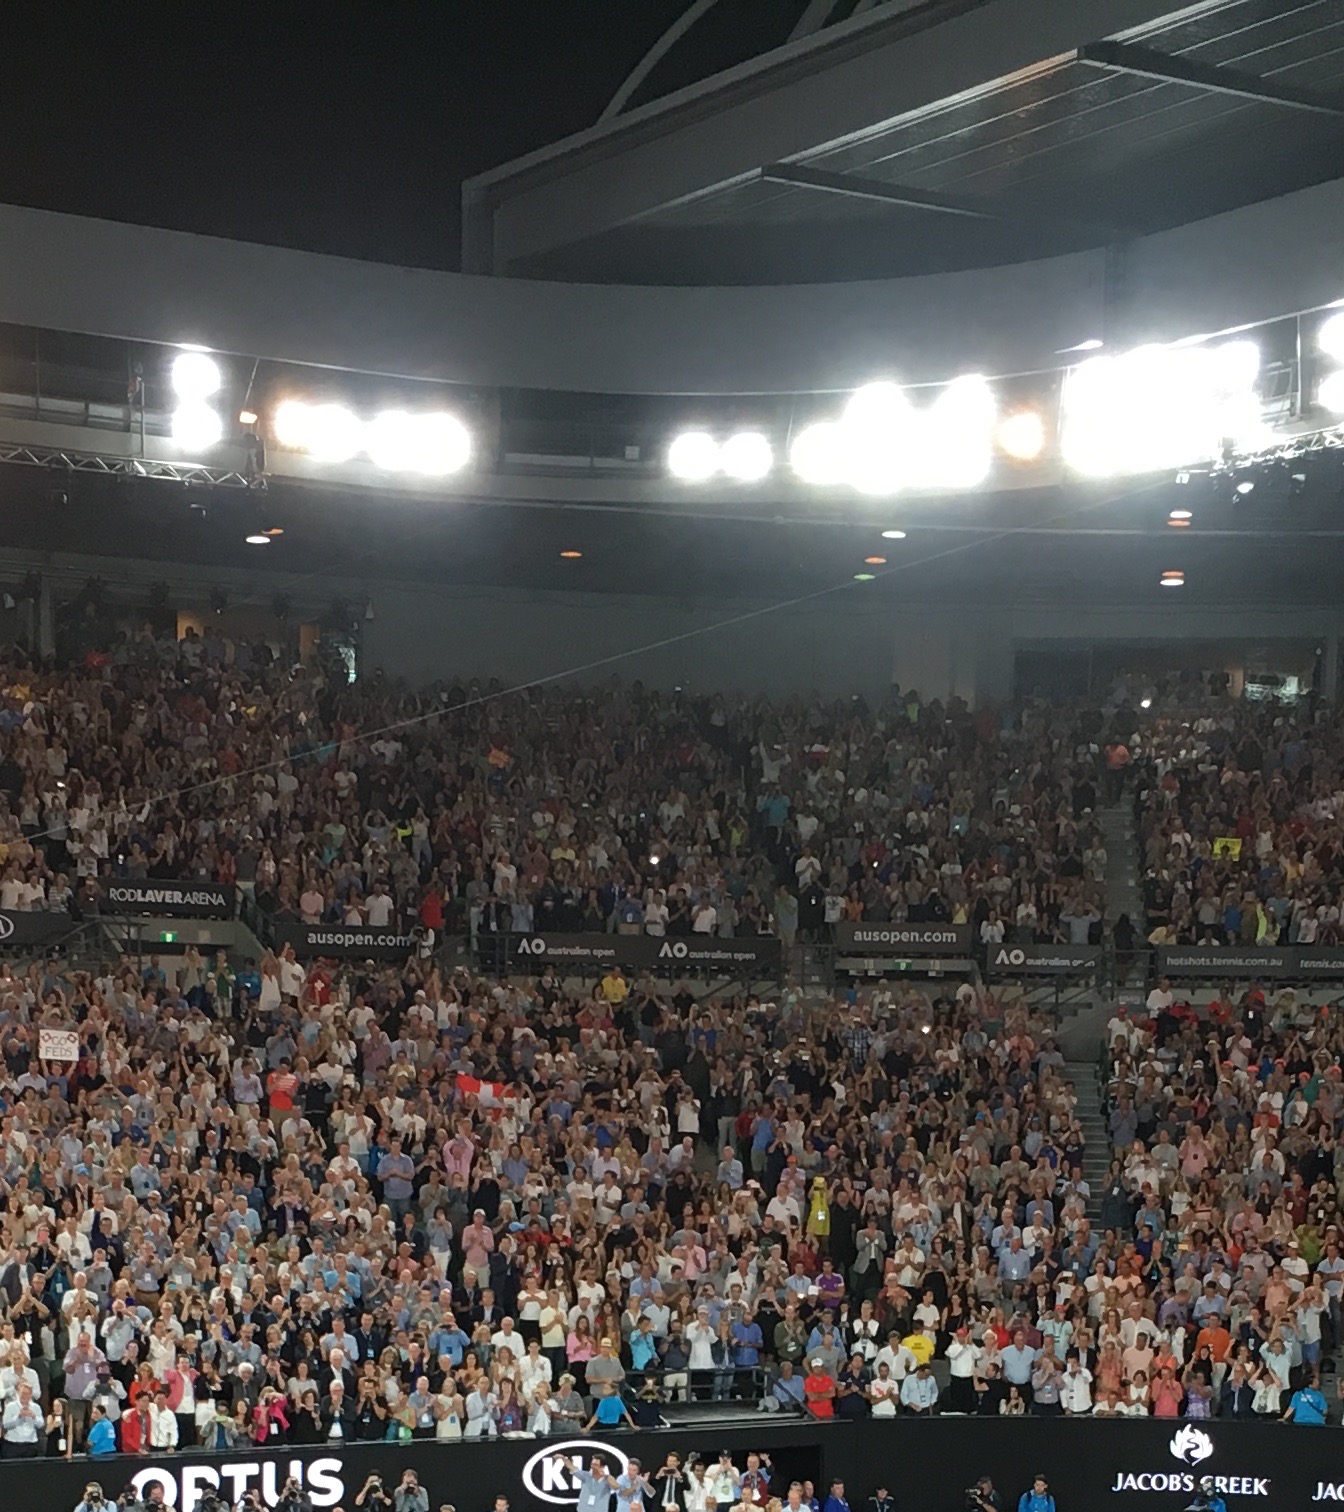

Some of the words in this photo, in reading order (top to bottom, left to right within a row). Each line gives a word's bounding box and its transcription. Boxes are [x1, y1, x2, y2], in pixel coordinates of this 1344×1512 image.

[307, 932, 410, 947] ausopen.com
[853, 930, 957, 944] ausopen.com
[517, 938, 546, 954] AO
[659, 942, 688, 958] AO
[994, 949, 1025, 965] AO
[51, 1036, 67, 1047] GO
[44, 1046, 73, 1057] FEDS
[1112, 1471, 1195, 1493] JACOB'S
